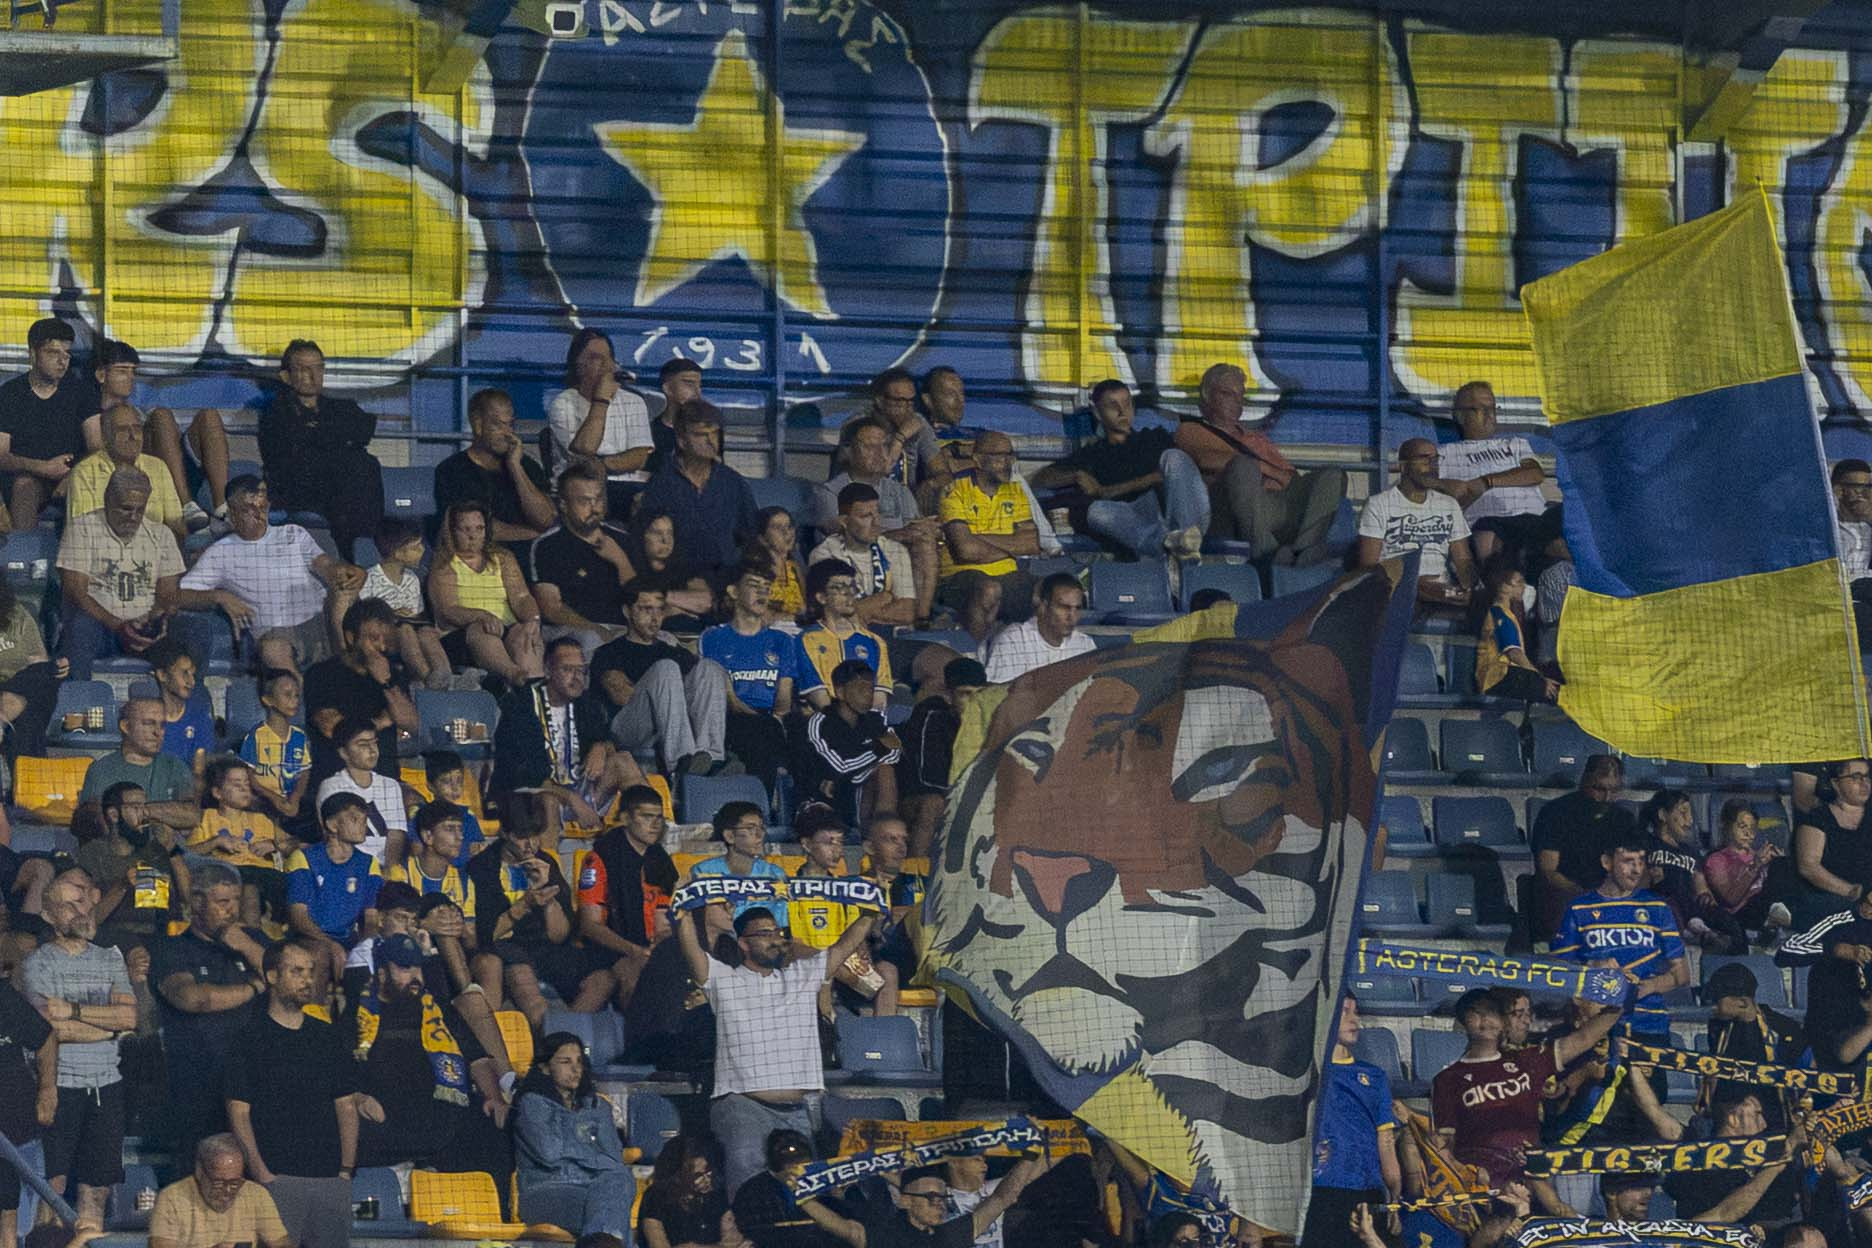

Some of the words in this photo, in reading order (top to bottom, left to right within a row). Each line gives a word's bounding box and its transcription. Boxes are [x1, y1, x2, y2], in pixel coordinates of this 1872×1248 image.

[630, 325, 832, 373] 1931
[790, 880, 886, 900] ΤΡΙΠΟΛ
[1375, 949, 1521, 980] ASTERAS
[1527, 965, 1568, 988] FC
[1648, 1047, 1840, 1094] TIGERS
[1546, 1137, 1770, 1173] TIGERS
